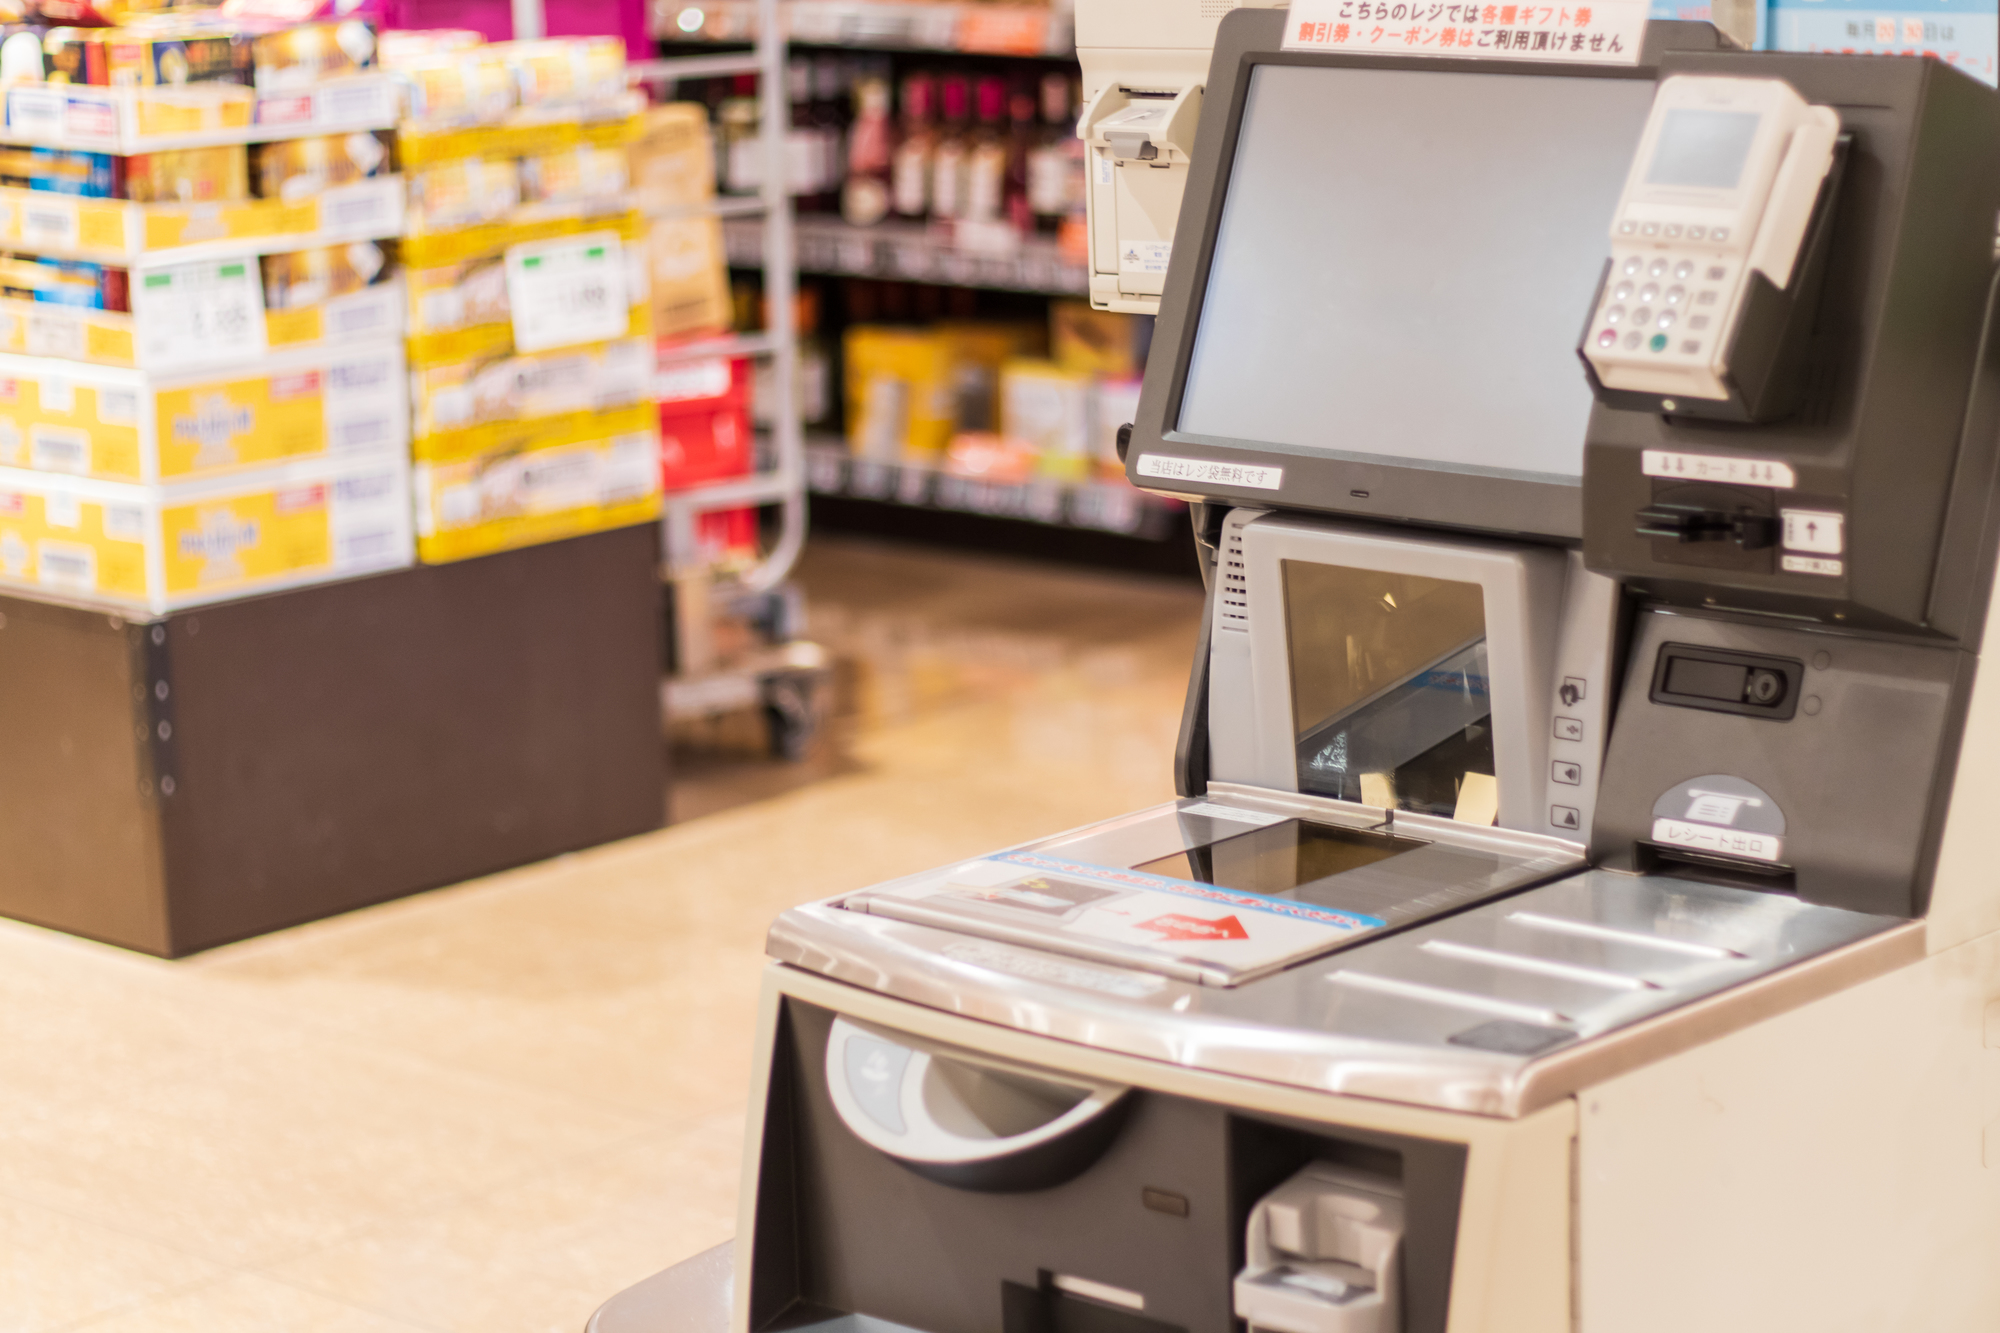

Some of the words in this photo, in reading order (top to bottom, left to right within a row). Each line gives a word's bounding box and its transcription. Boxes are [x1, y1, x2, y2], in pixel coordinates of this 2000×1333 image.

[1338, 1, 1592, 27] こちらのレジでは各種ギフト券
[1298, 22, 1624, 53] 割引券・クーポン券はご利用頂けません
[1150, 460, 1267, 485] 当店はレジ袋無料です
[1696, 461, 1737, 477] カード
[1668, 826, 1763, 853] レシート出口
